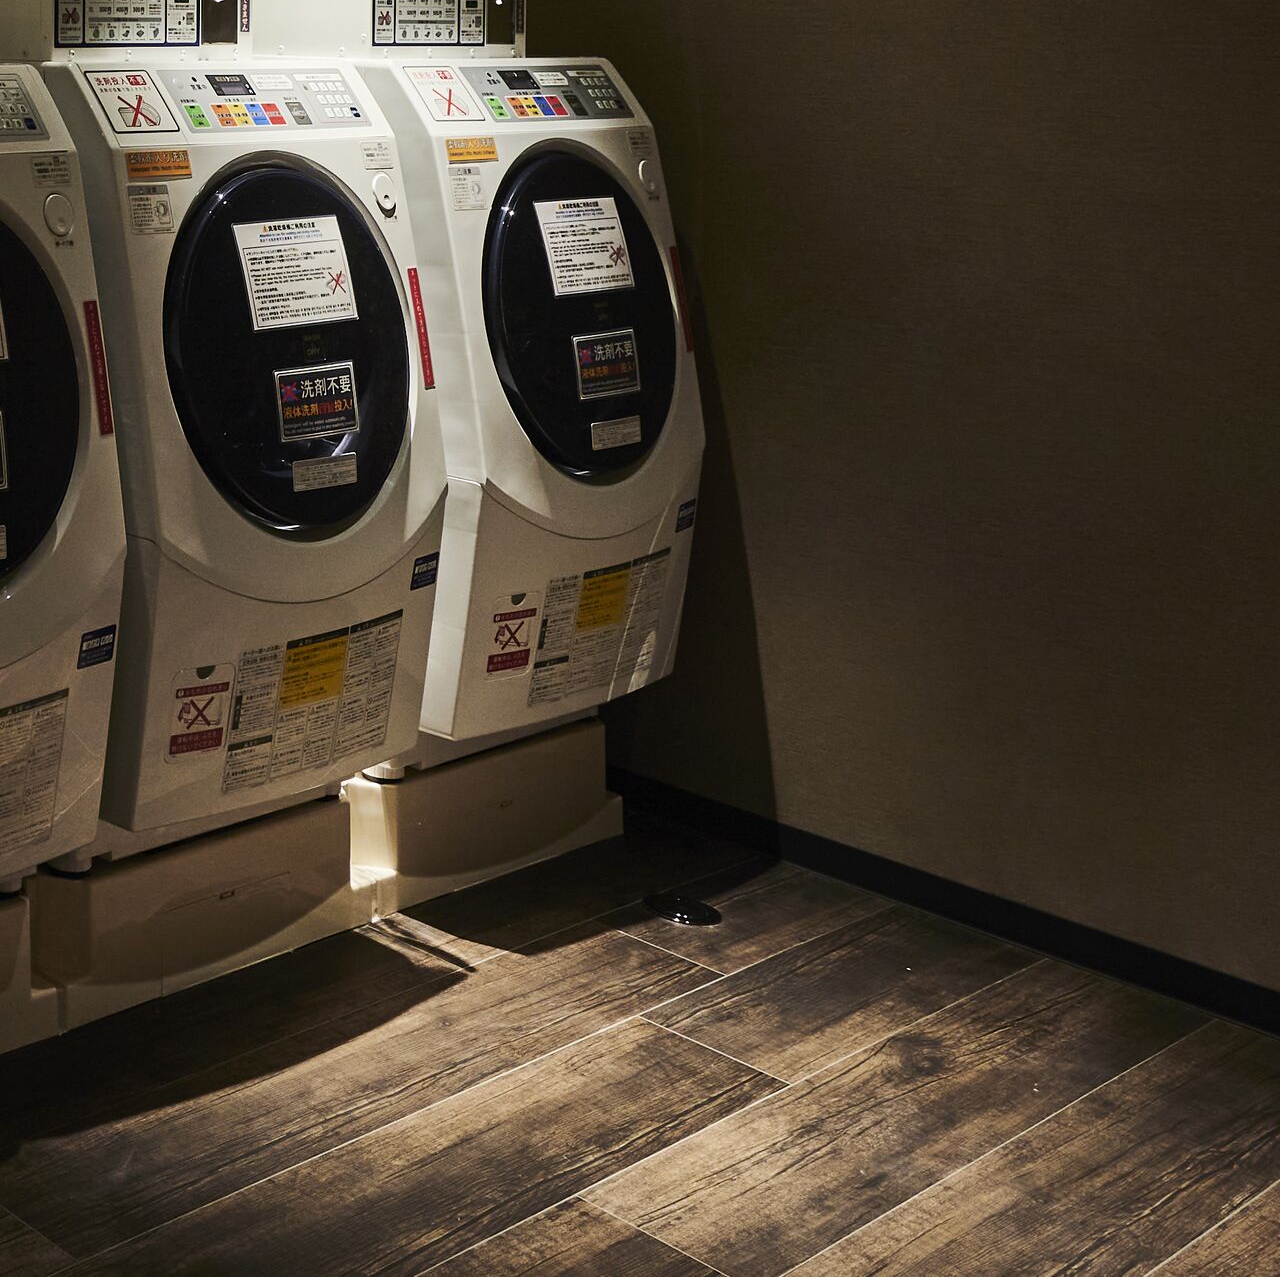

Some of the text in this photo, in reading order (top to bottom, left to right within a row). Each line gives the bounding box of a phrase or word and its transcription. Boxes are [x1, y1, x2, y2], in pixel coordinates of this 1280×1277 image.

[593, 341, 634, 362] 洗剤不要
[300, 375, 352, 399] 洗剤不要
